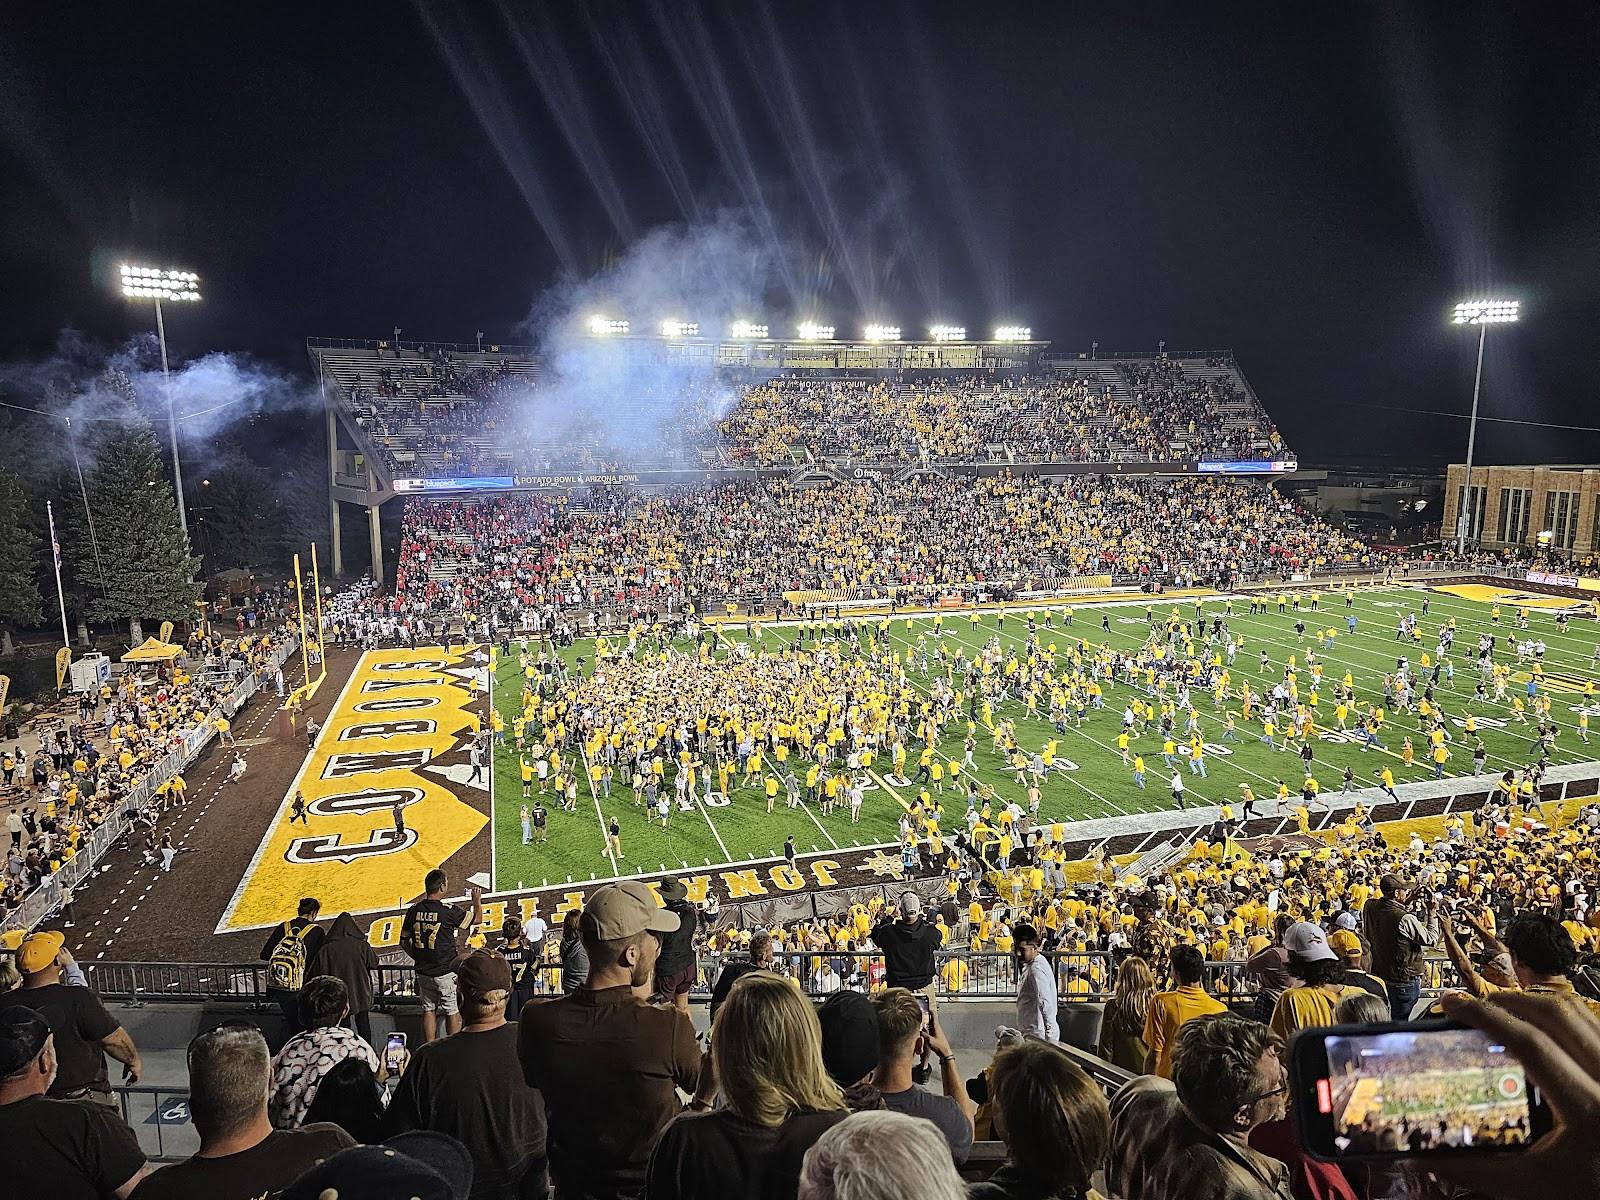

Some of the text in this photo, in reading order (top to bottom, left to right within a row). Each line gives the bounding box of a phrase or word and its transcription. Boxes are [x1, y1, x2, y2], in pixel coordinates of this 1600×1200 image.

[585, 475, 616, 483] ARIZONA
[284, 660, 447, 864] COWBOYS
[415, 911, 438, 922] ALLEN
[413, 921, 442, 949] 17
[504, 952, 522, 960] ALLEN
